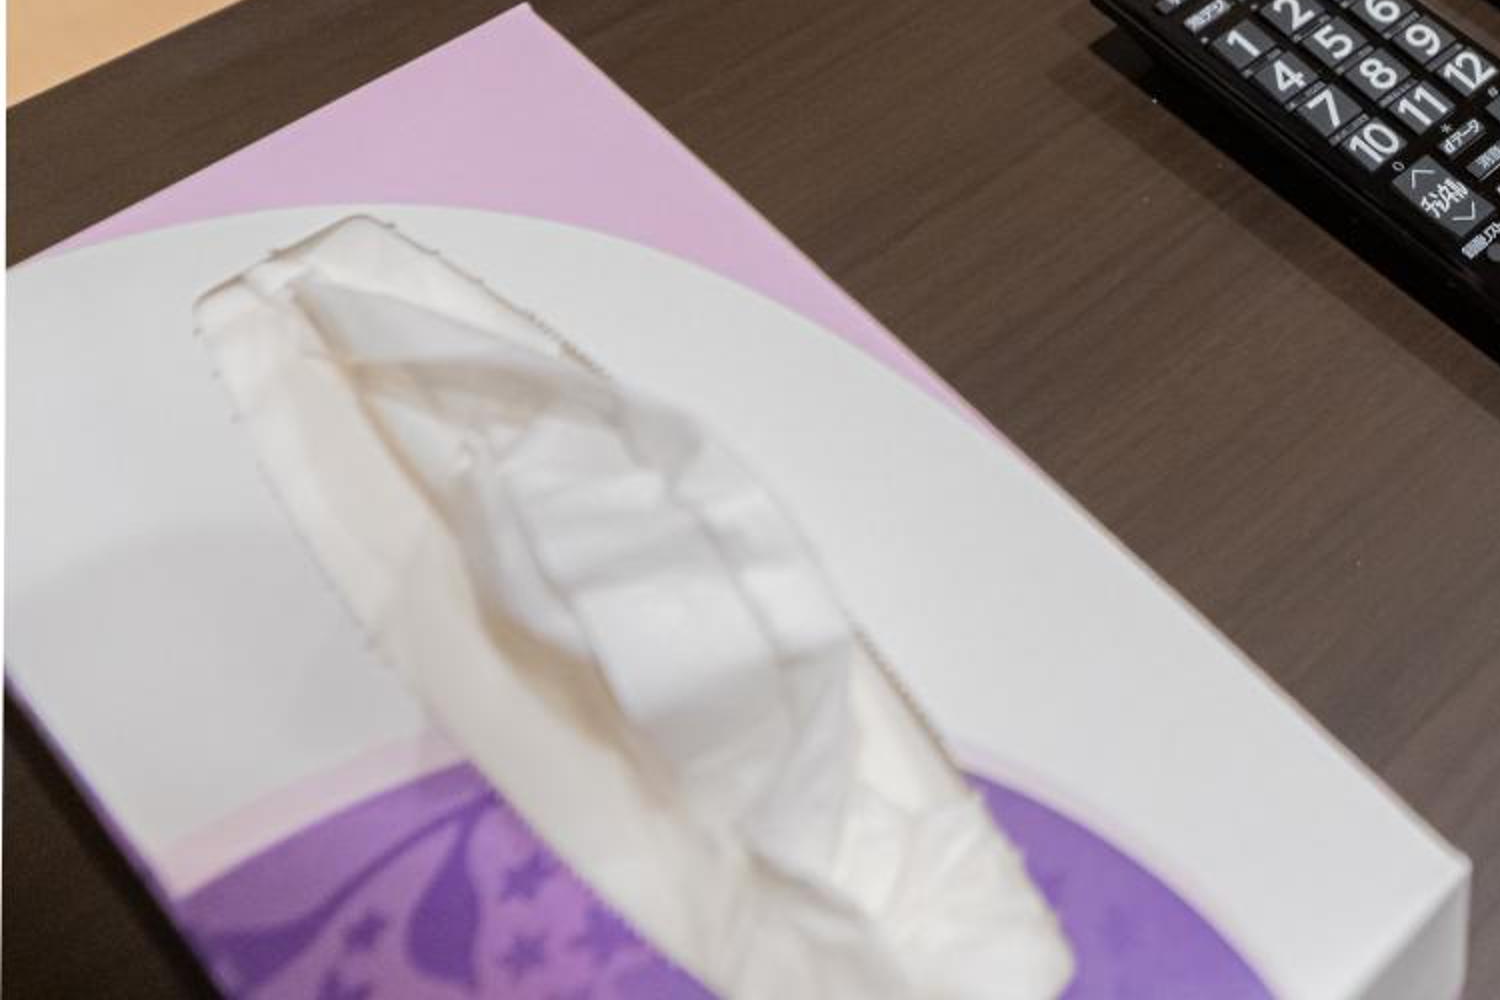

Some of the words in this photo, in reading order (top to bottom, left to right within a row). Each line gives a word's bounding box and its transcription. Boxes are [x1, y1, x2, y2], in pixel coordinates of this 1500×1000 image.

[1226, 29, 1261, 58] 1
[1313, 24, 1353, 59] 5
[1405, 23, 1441, 56] 9
[1273, 59, 1308, 92] 4
[1359, 57, 1398, 90] 8
[1443, 51, 1499, 91] 12
[1306, 88, 1341, 128] 7
[1398, 86, 1449, 126] 11
[1349, 122, 1400, 163] 10
